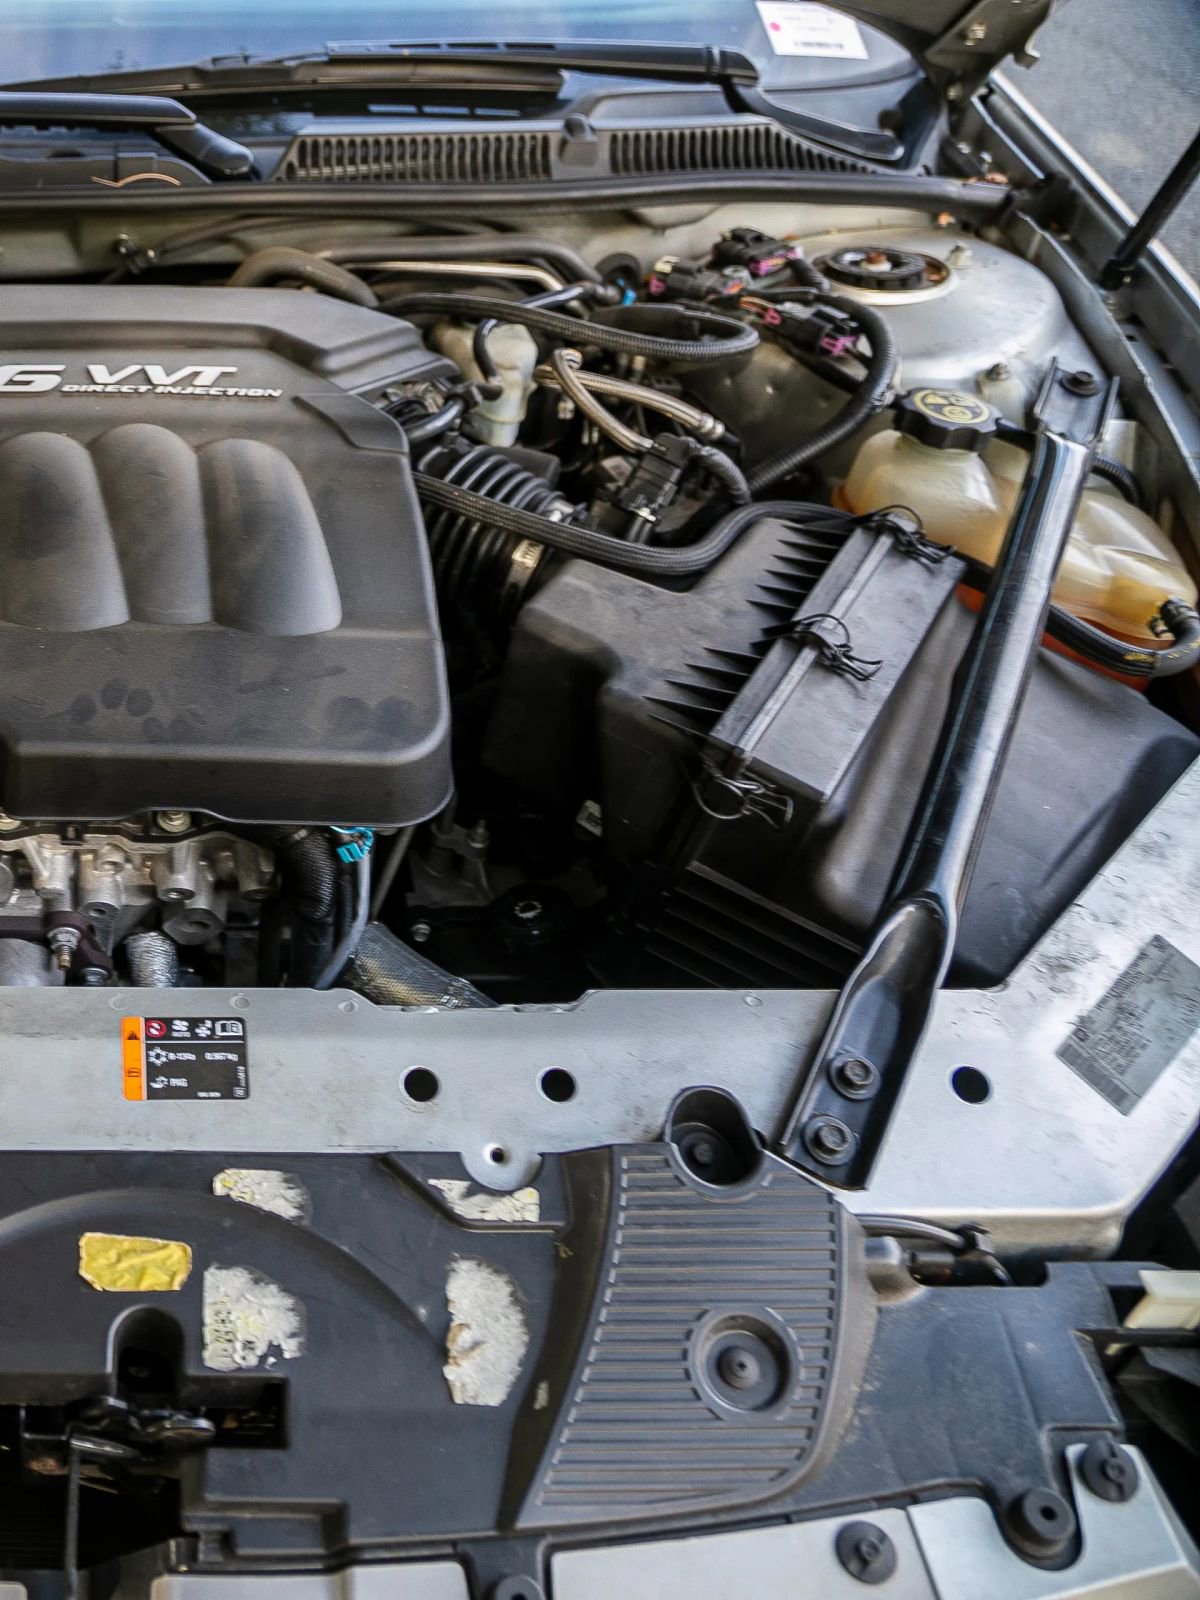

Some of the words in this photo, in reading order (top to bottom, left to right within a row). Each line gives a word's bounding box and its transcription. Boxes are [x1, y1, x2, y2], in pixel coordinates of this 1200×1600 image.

[87, 364, 238, 387] VVT
[60, 384, 150, 395] DIRECT
[153, 385, 283, 398] INJECTION
